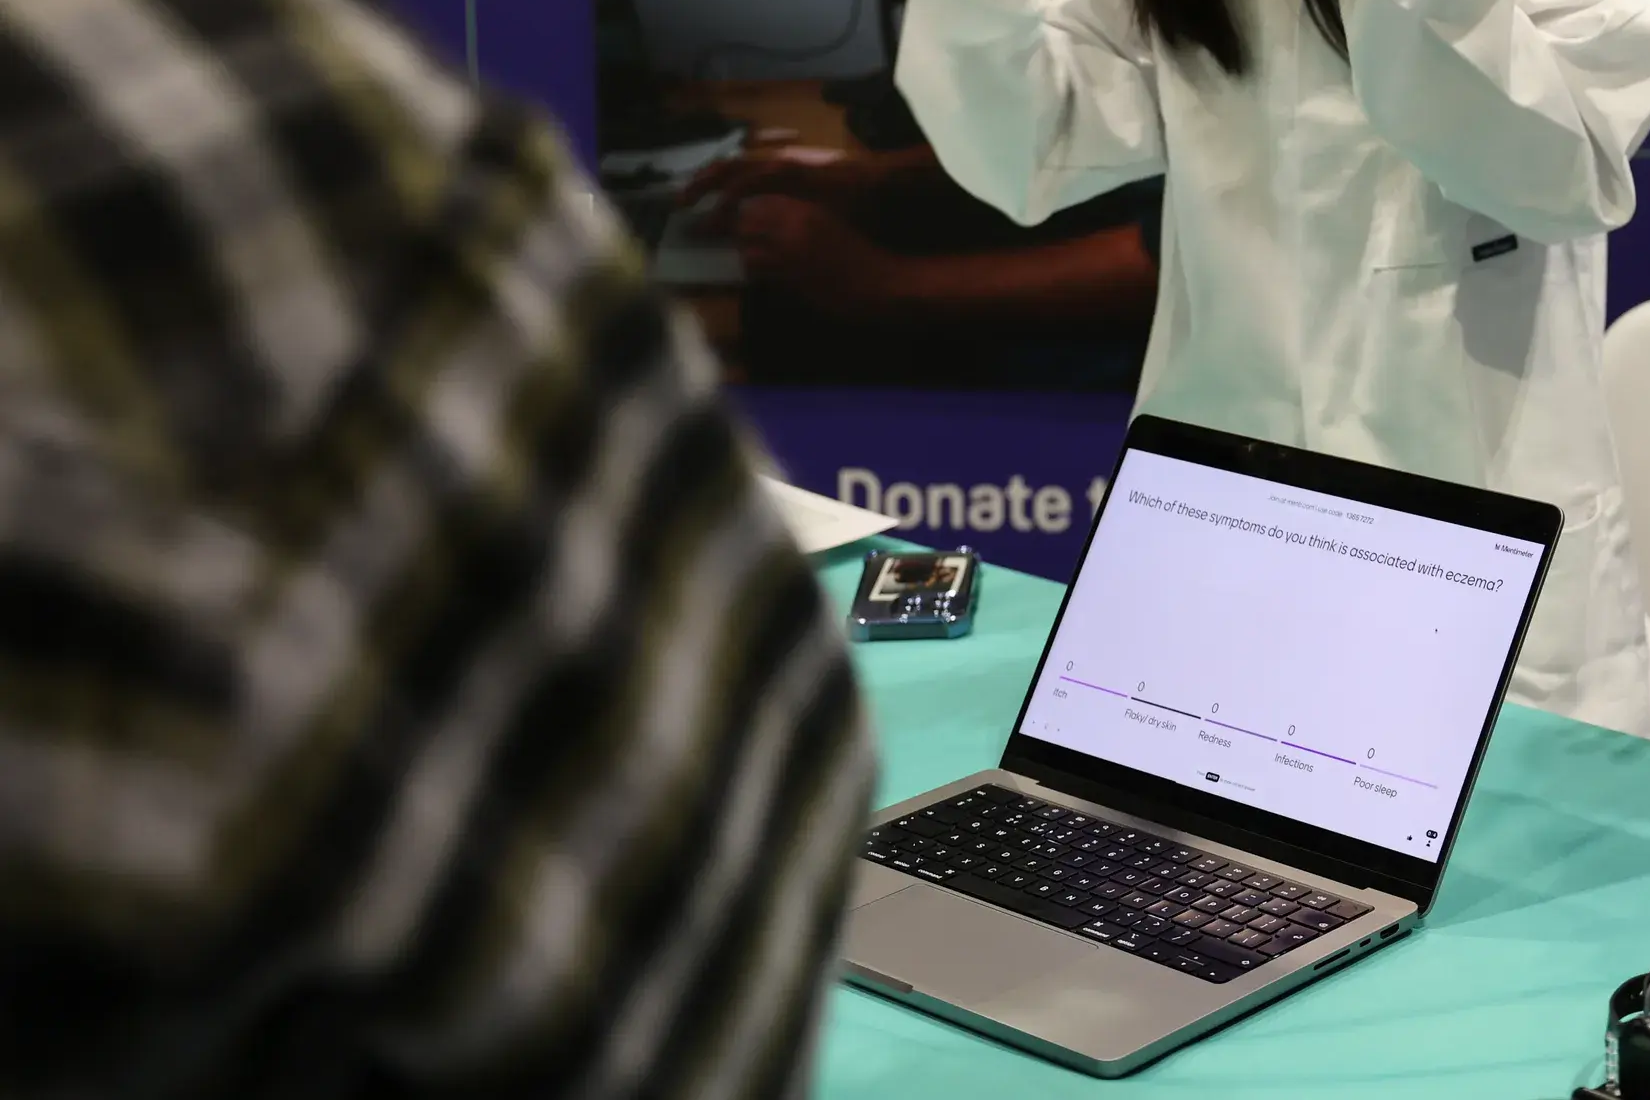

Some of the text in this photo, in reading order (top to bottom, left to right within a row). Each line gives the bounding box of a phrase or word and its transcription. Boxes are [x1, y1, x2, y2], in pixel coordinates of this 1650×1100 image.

[837, 466, 1072, 533] Donate
[1128, 489, 1504, 593] Which of these symptoms do you think is associated with eczema?
[1501, 544, 1534, 559] Mentimeter
[1066, 660, 1074, 672] 0
[1052, 687, 1068, 699] Itch
[1137, 681, 1146, 693] 0
[1211, 702, 1220, 715] 0
[1124, 707, 1177, 732] Flaky/ dry skin
[1287, 724, 1296, 737] 0
[1198, 729, 1232, 749] Redness
[1367, 747, 1376, 760] 0
[1274, 753, 1314, 773] Infections
[1353, 776, 1398, 799] Poor sleep
